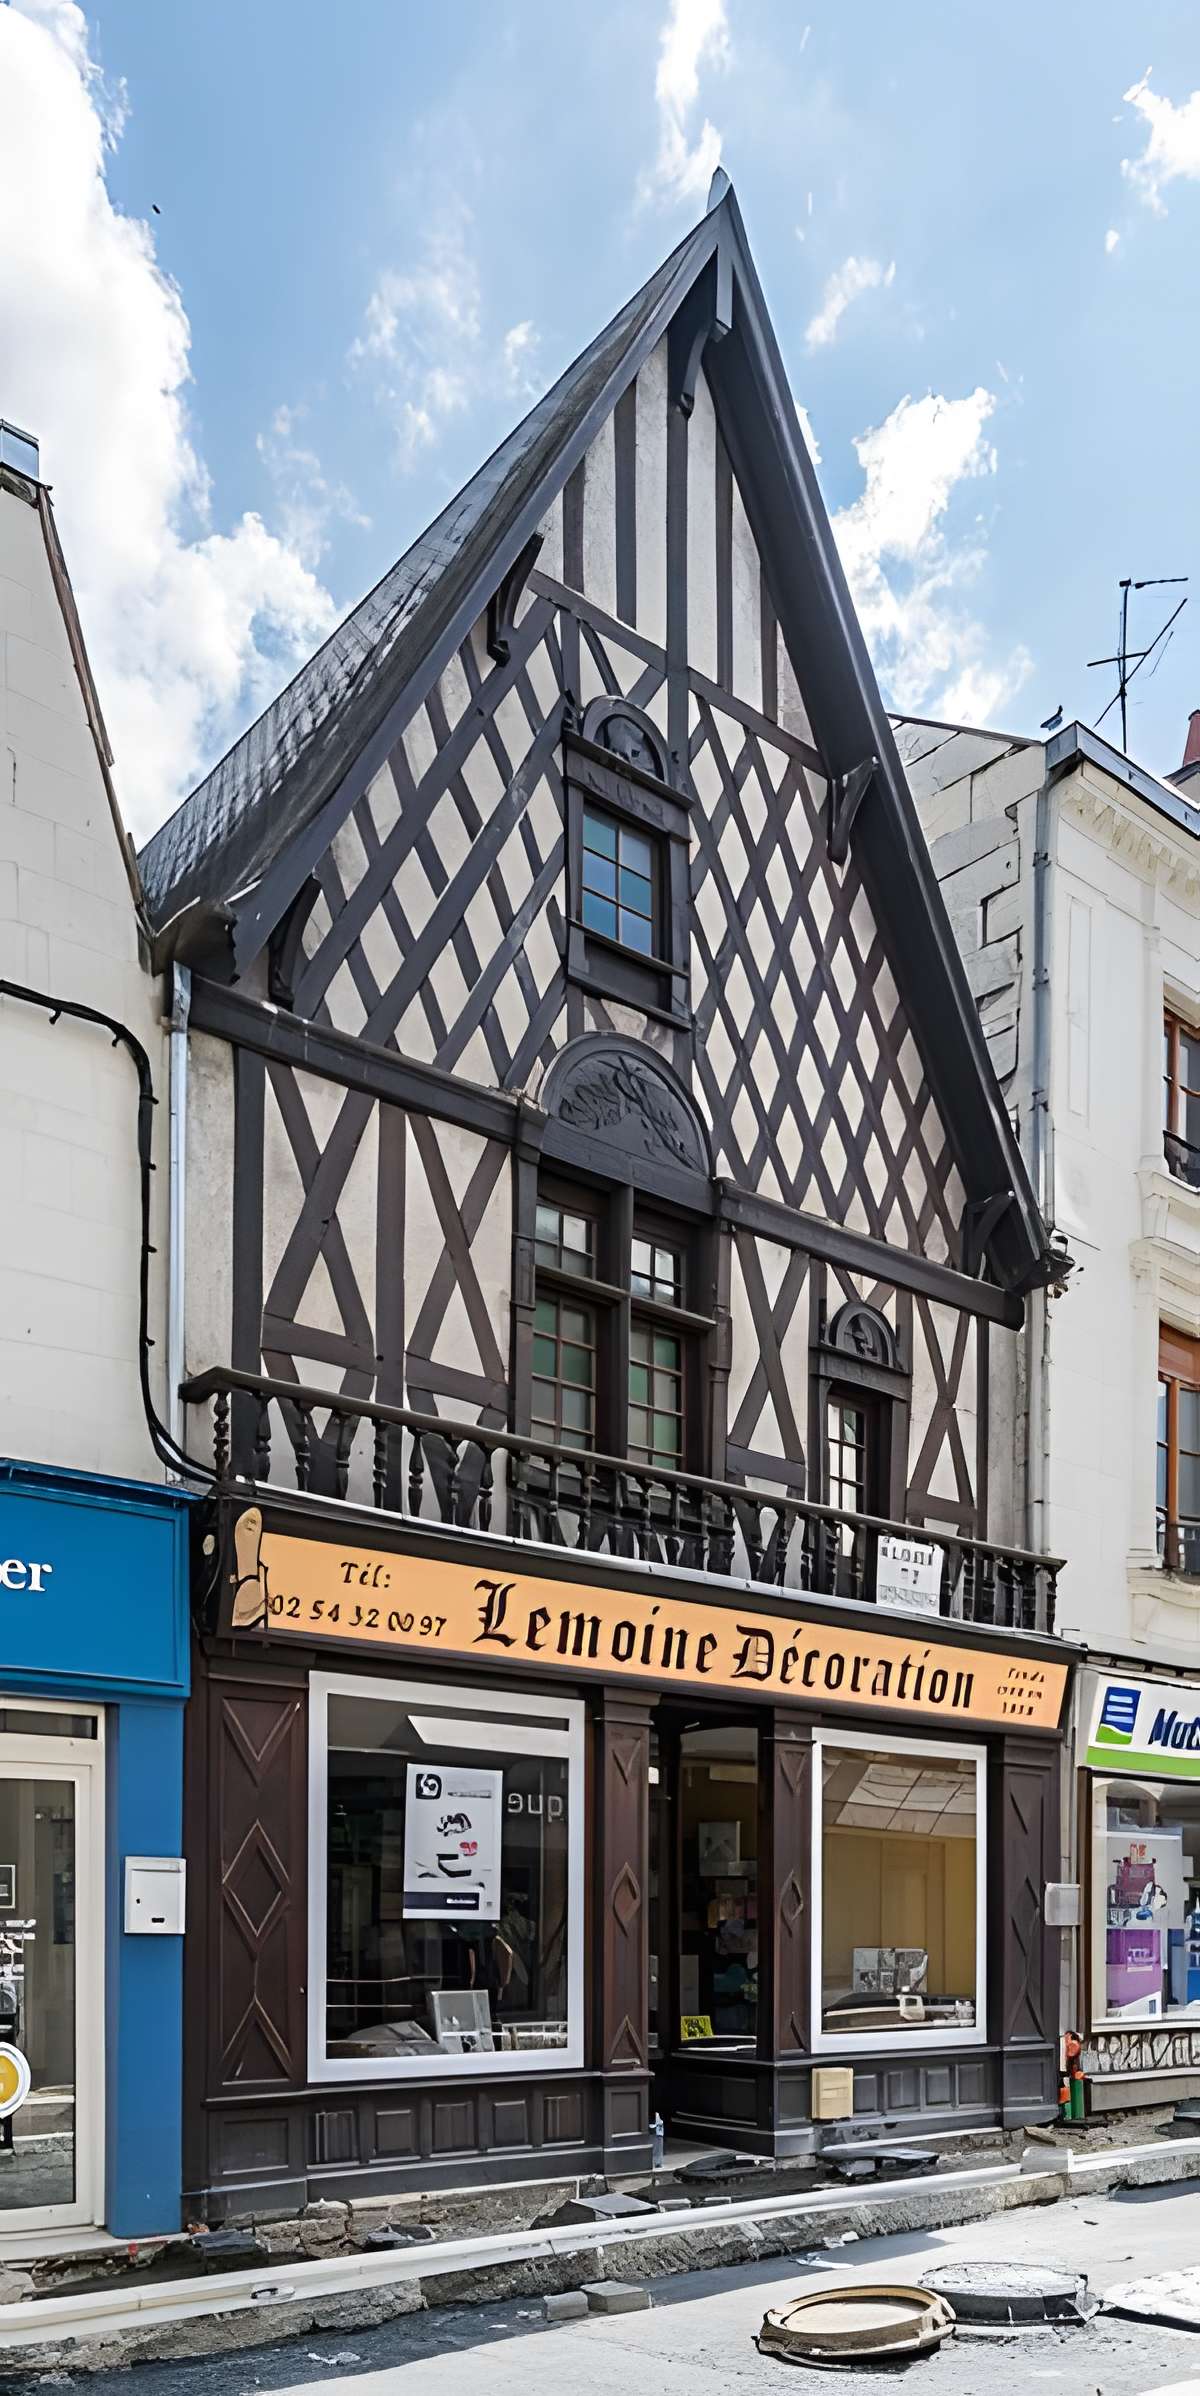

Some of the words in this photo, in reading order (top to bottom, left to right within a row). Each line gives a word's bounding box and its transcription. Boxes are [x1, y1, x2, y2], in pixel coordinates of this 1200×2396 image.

[0, 1558, 53, 1592] er
[271, 1594, 301, 1619] 02
[419, 1615, 447, 1637] 97
[472, 1579, 718, 1673] Lemoine
[730, 1624, 974, 1709] Décoration
